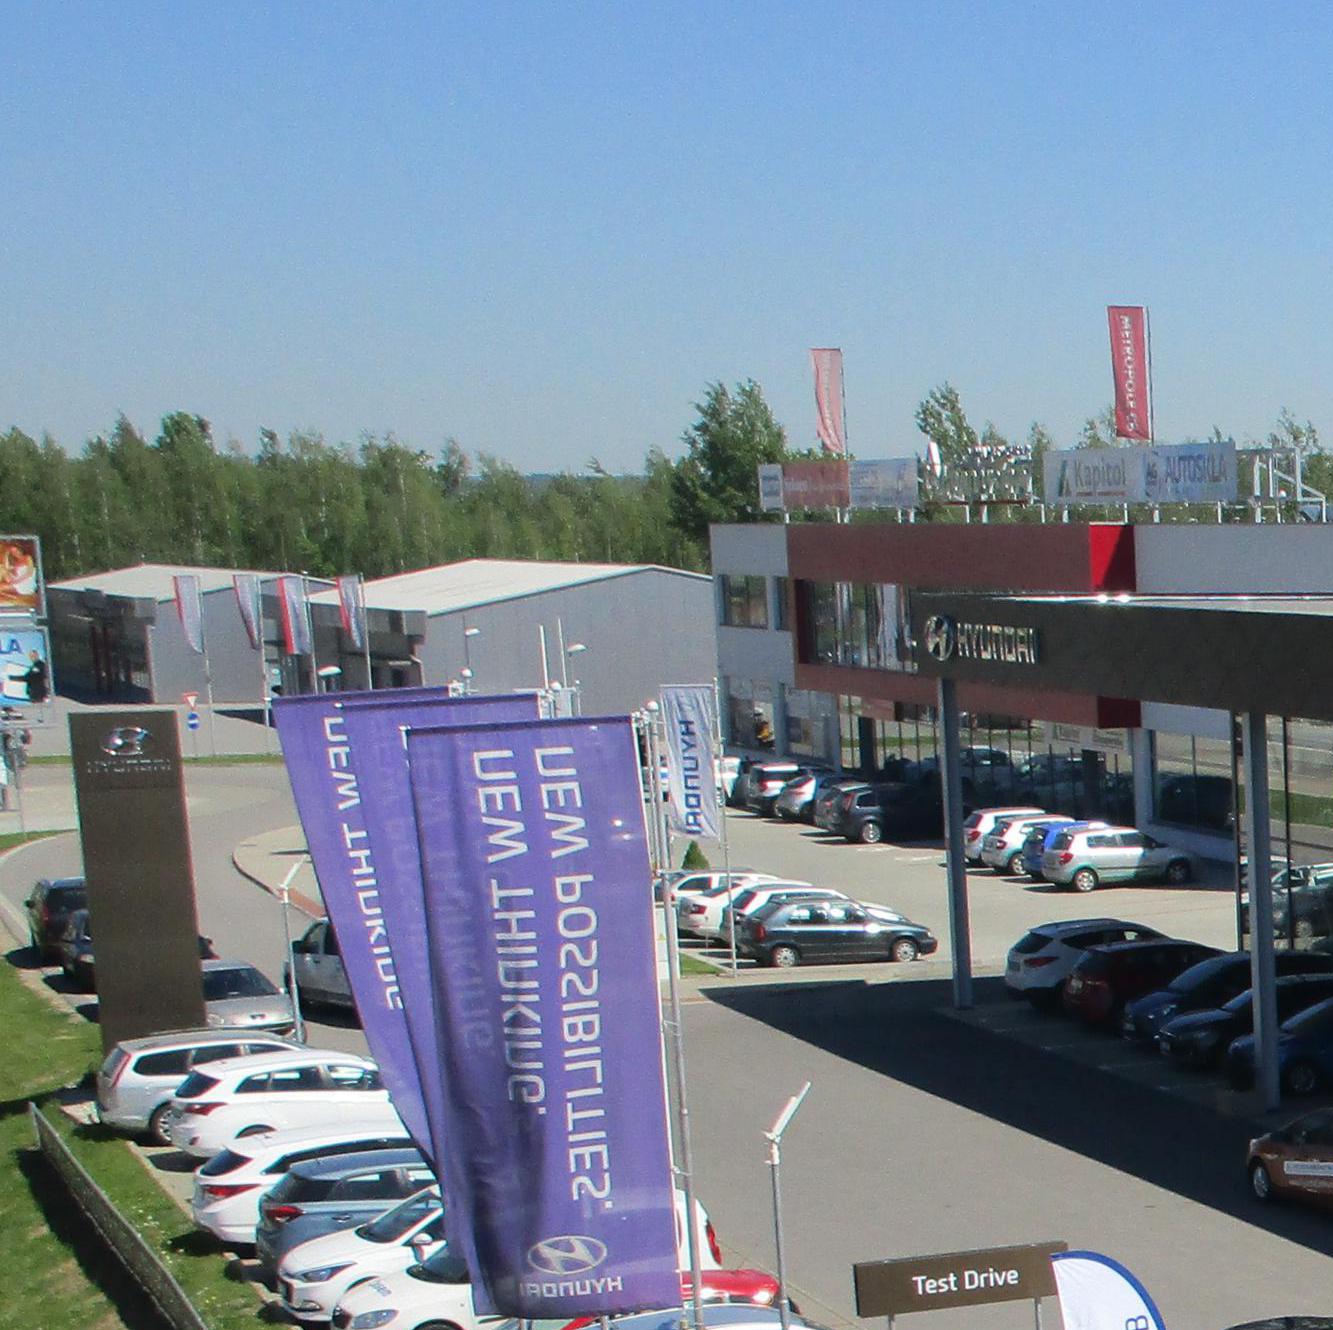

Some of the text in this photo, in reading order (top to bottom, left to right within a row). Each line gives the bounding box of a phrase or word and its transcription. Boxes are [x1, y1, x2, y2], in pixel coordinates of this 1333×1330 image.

[956, 621, 1036, 665] HYUNDAI
[911, 1266, 1020, 1296] Test Drive
